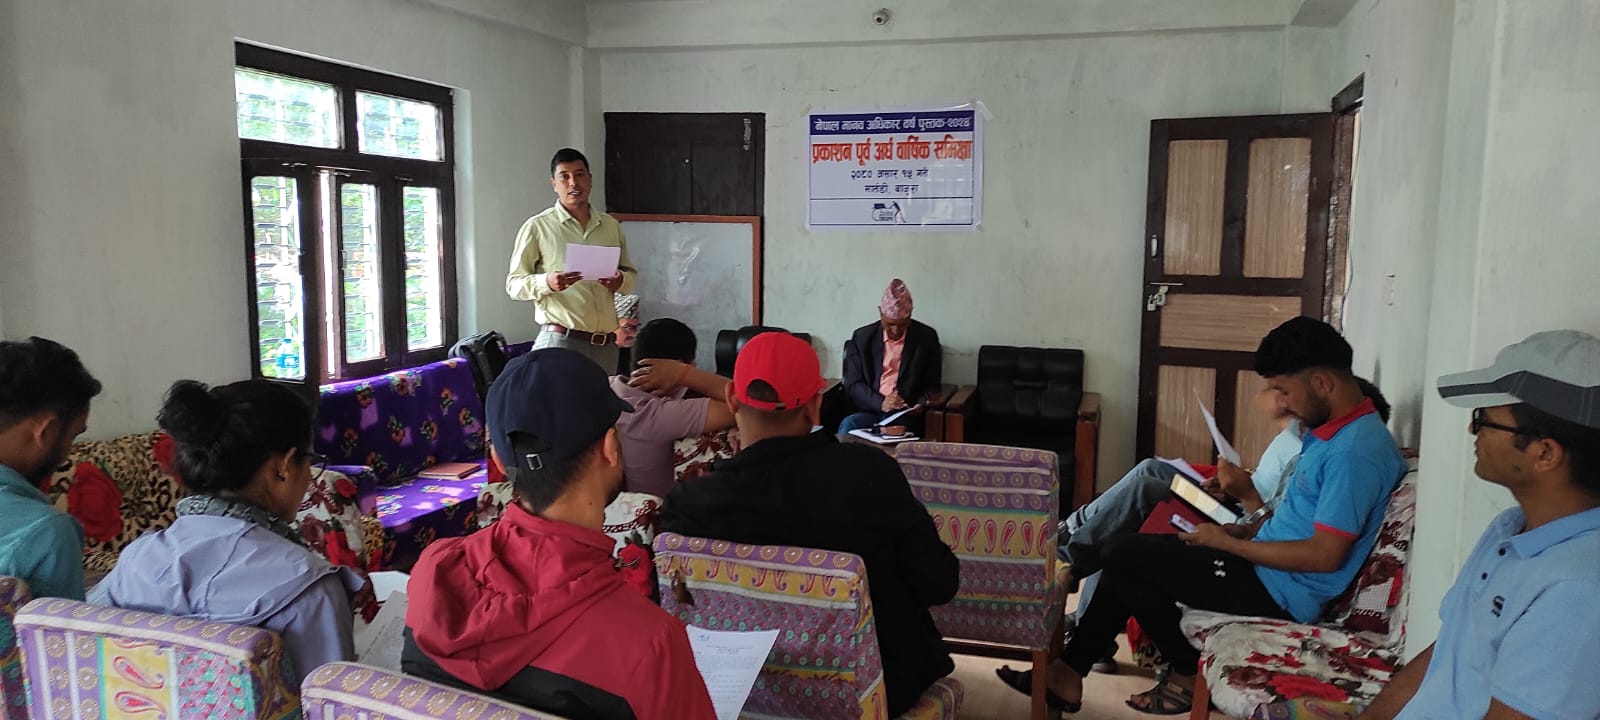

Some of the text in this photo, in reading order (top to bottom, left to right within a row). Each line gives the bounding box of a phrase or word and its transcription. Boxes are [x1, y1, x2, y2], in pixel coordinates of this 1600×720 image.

[814, 118, 840, 131] नेपाल
[841, 120, 864, 130] मानव
[866, 116, 901, 130] अधिकार
[903, 116, 916, 129] वर्ष
[812, 143, 853, 164] प्रकाशन
[855, 137, 872, 166] पूर्व
[896, 134, 932, 160] वार्षिक
